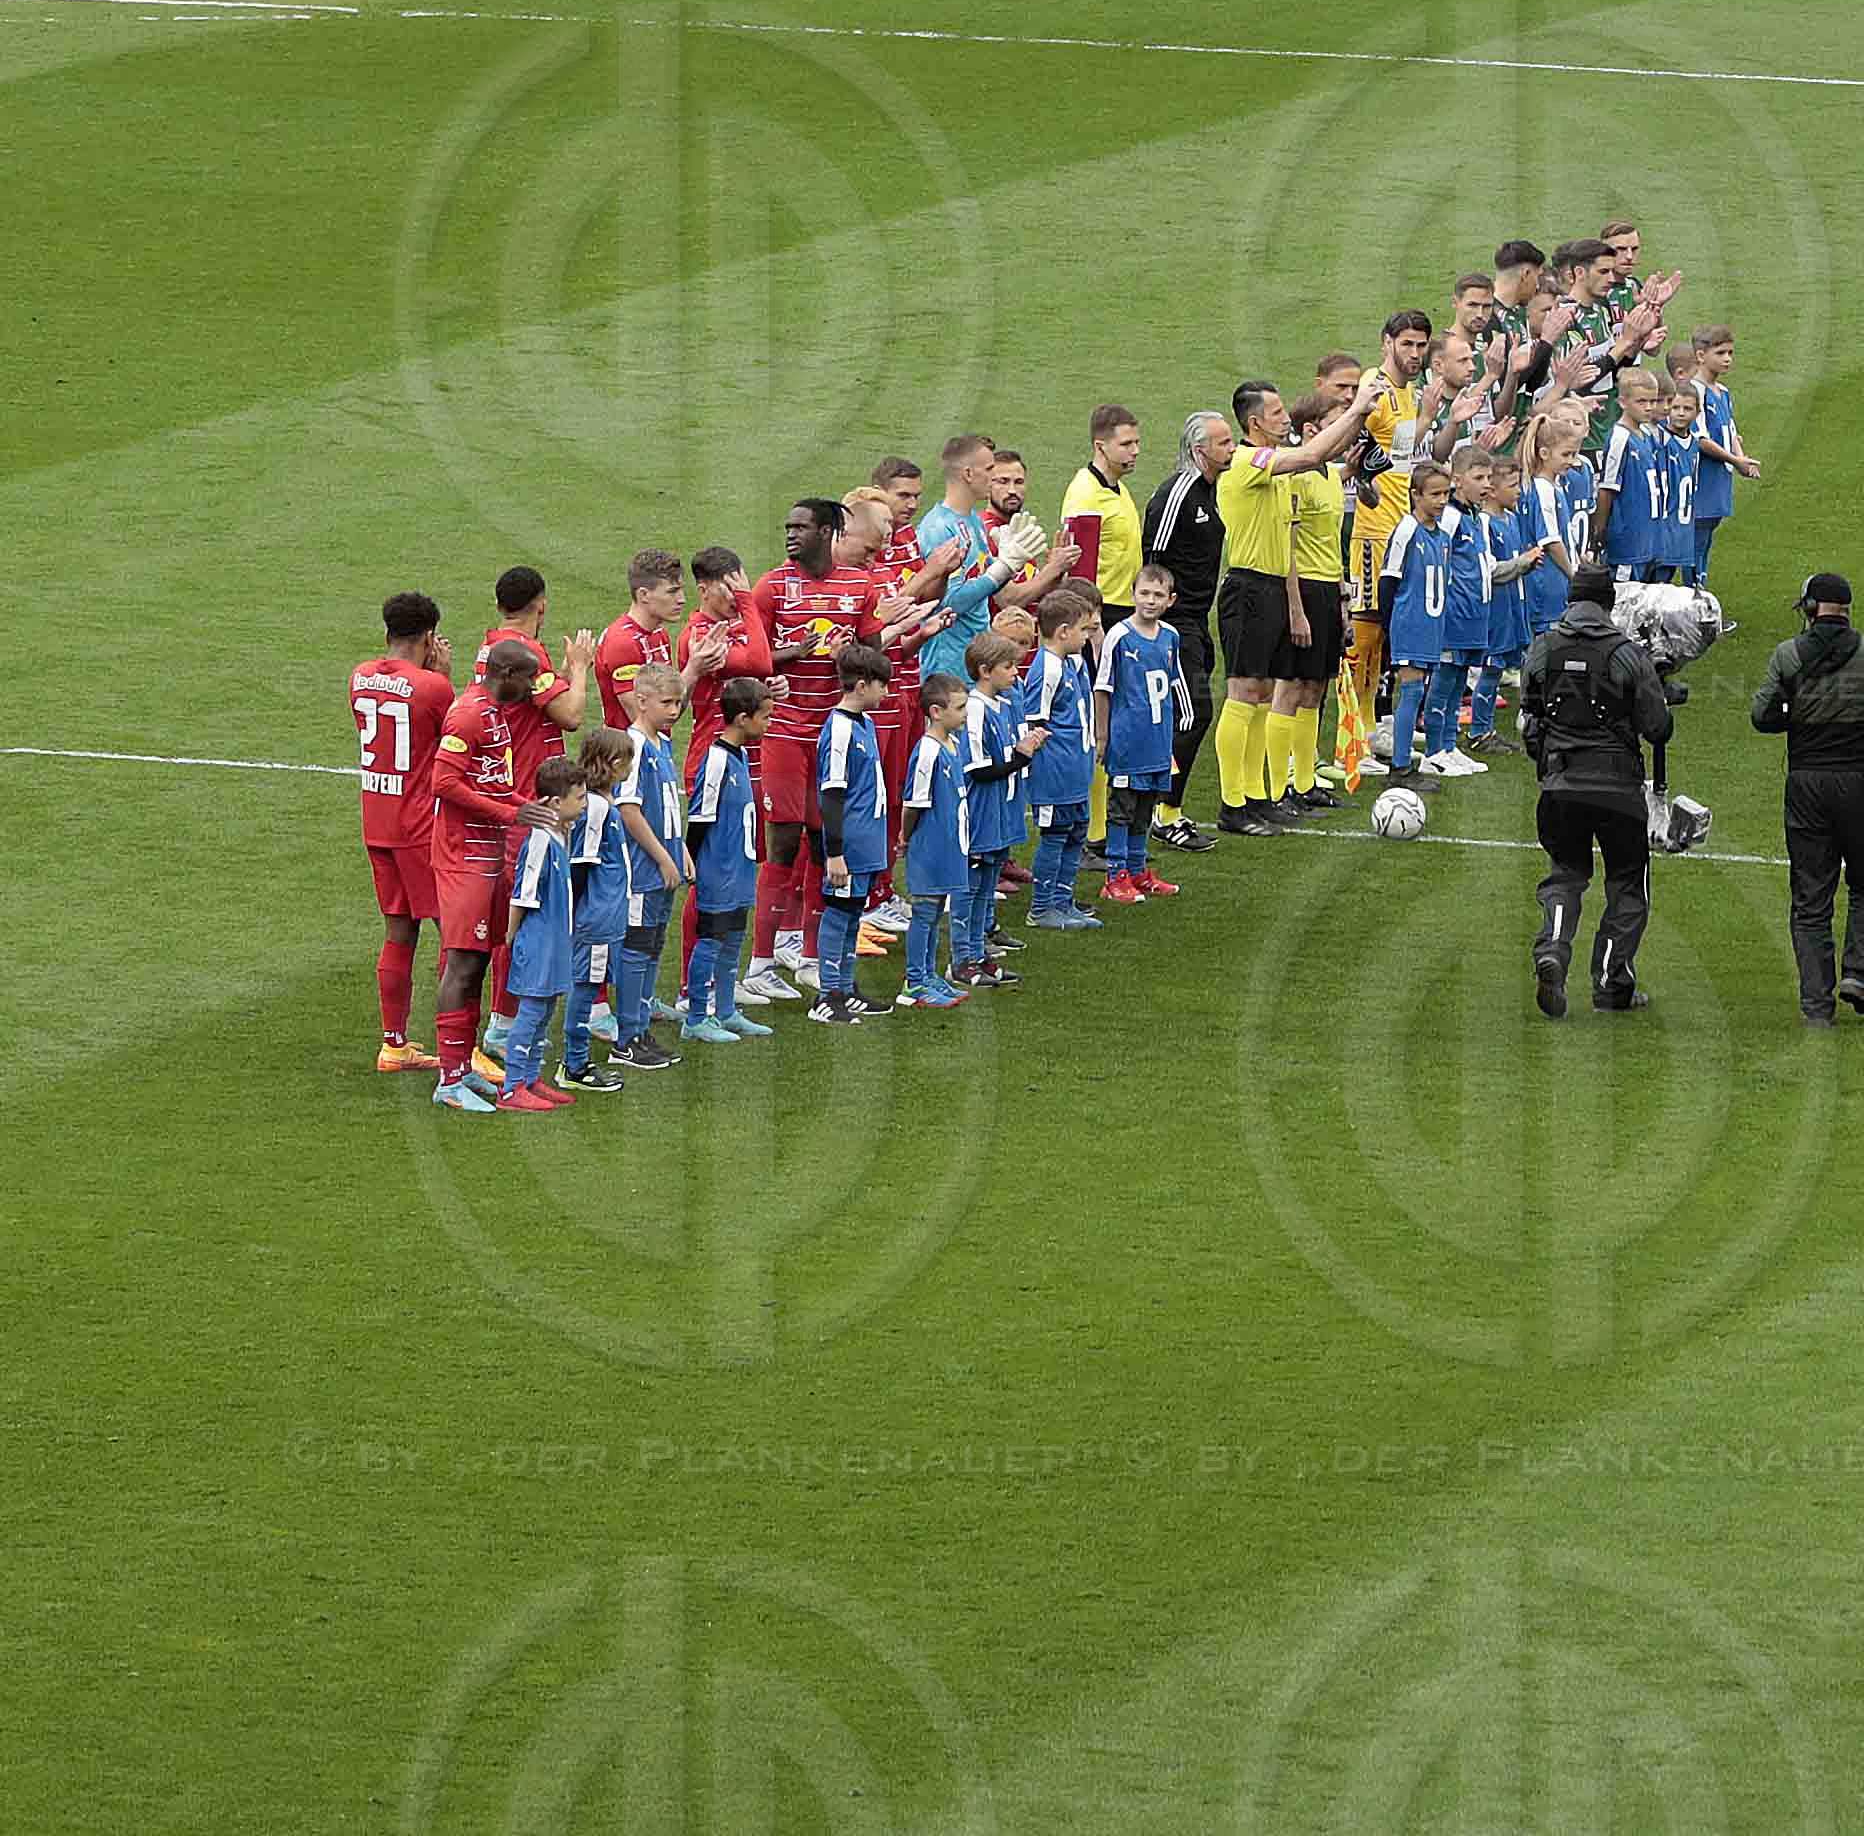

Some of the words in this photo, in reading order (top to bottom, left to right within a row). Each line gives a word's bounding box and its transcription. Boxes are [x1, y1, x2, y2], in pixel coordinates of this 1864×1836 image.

[1425, 565, 1445, 618] U
[1145, 670, 1170, 724] P
[354, 697, 410, 772] 27
